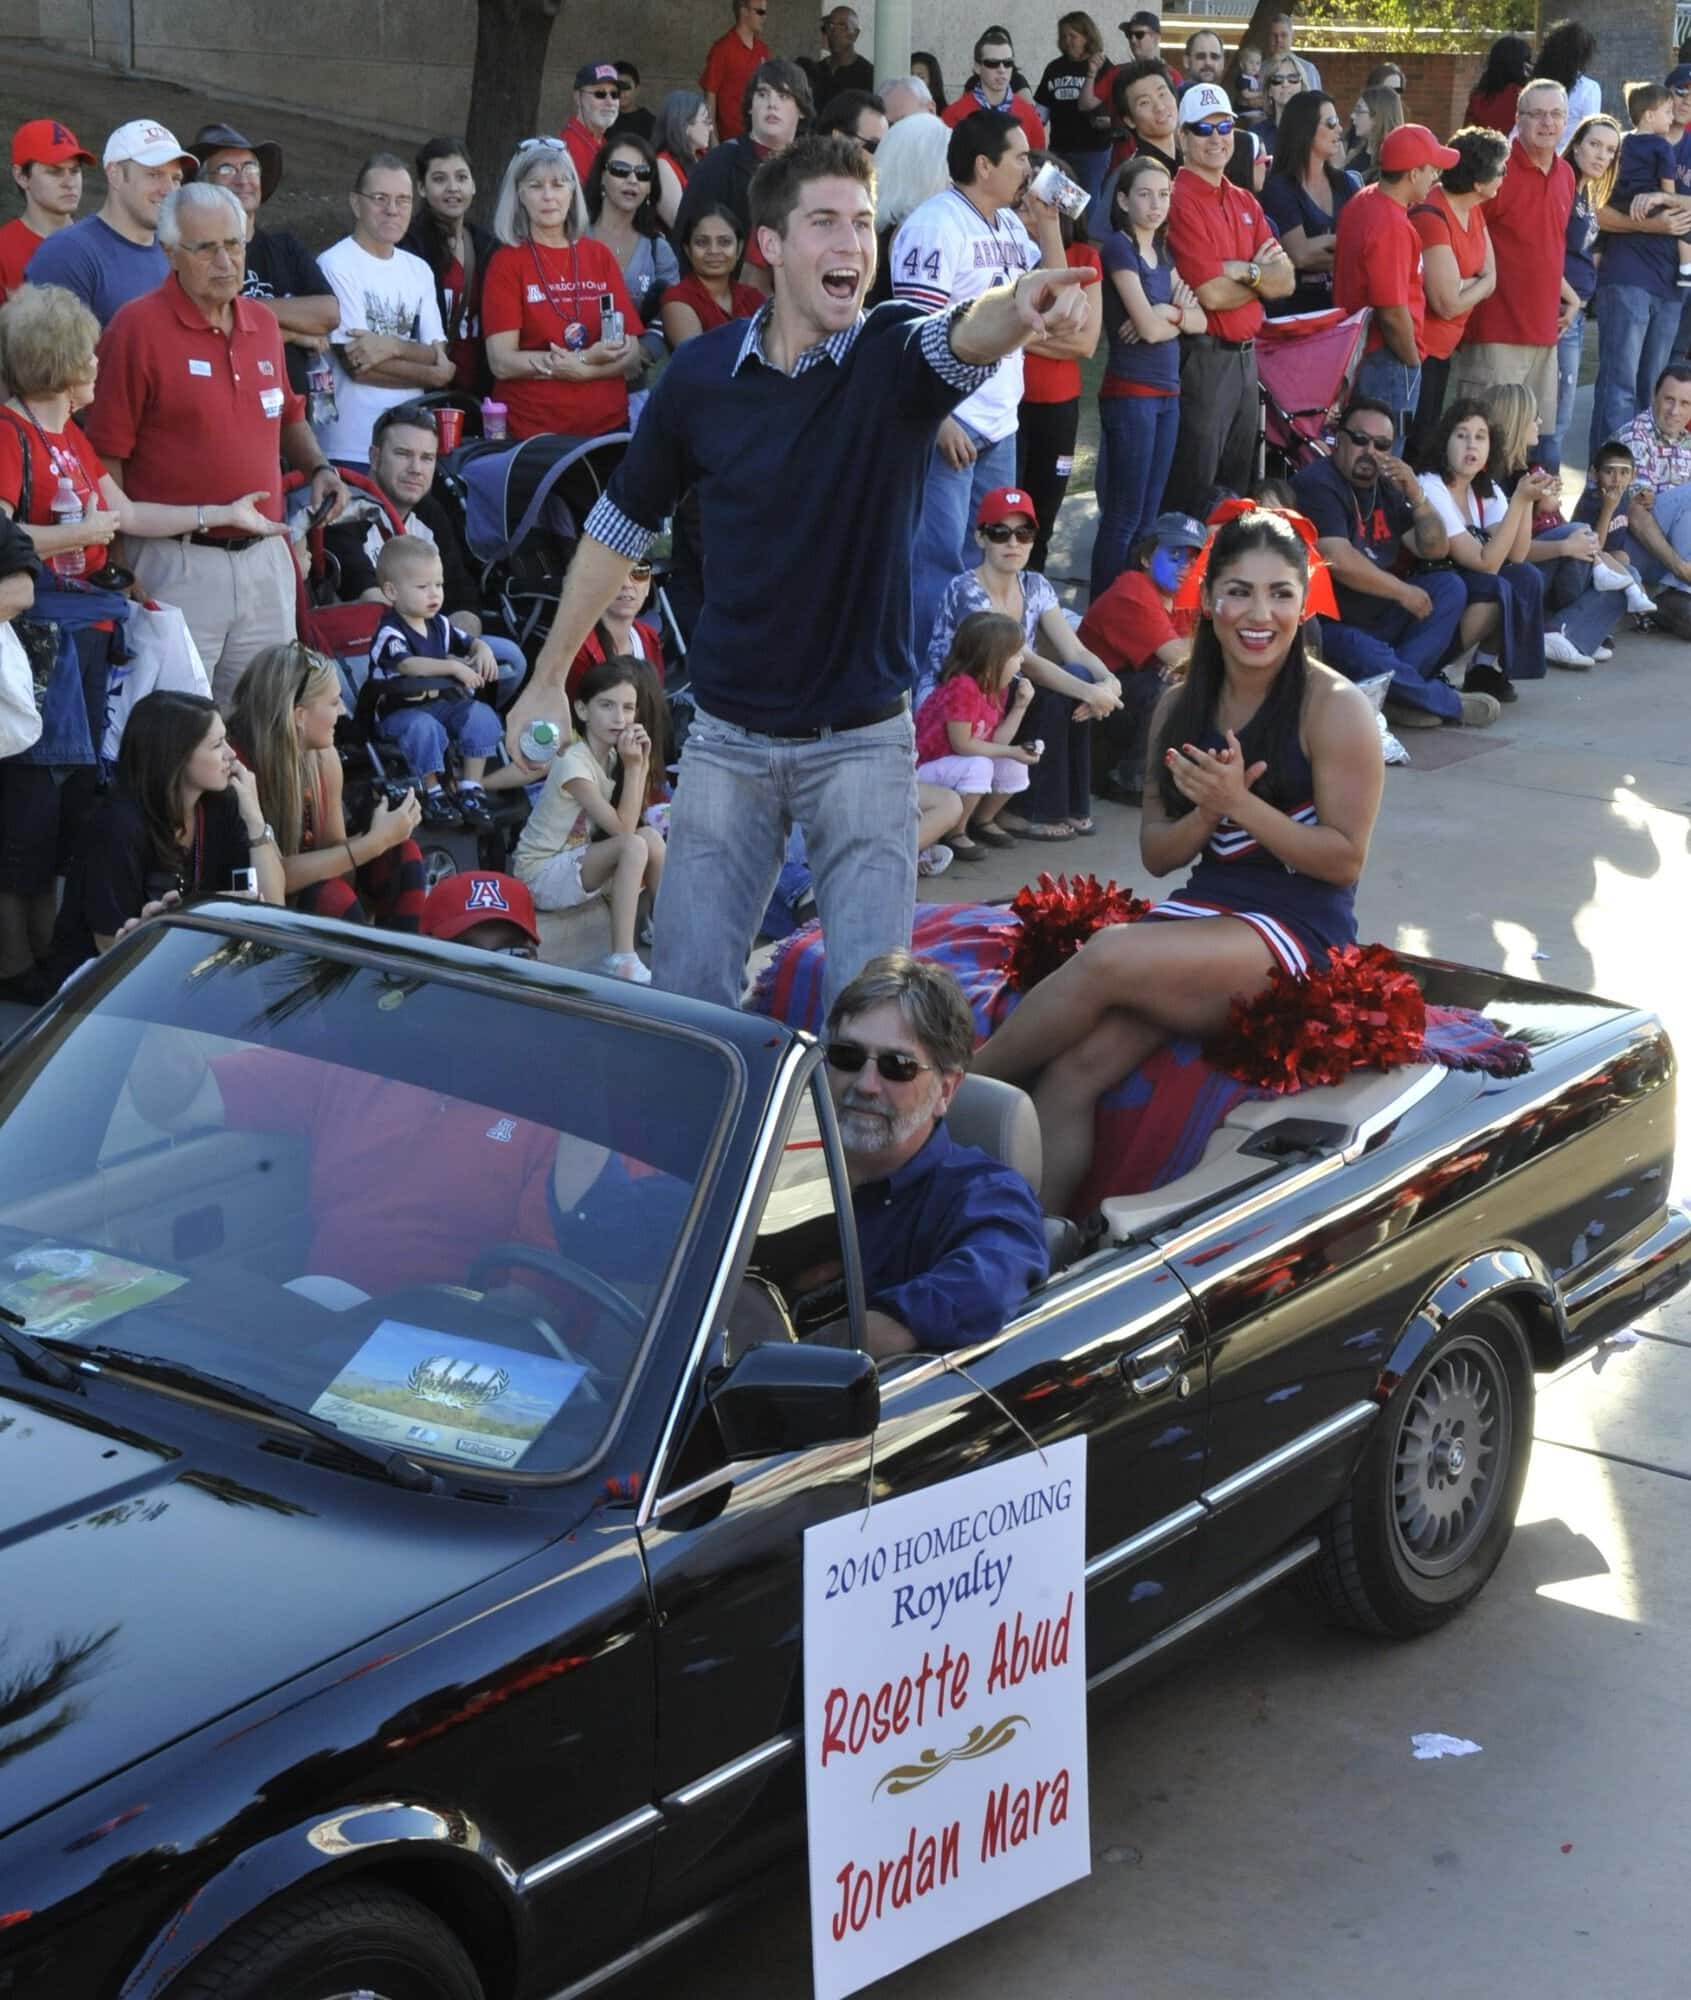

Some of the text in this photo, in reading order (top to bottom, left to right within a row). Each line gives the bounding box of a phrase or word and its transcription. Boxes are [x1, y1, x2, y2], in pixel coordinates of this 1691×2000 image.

[1200, 89, 1220, 106] A
[53, 121, 75, 145] A
[903, 247, 942, 280] 44
[465, 879, 510, 912] A
[825, 1479, 1072, 1600] 2010 HOMECOMING
[891, 1549, 1013, 1630] Royalty
[821, 1591, 1074, 1767] Rosette Abud
[832, 1768, 1070, 1942] Jordan Mara
